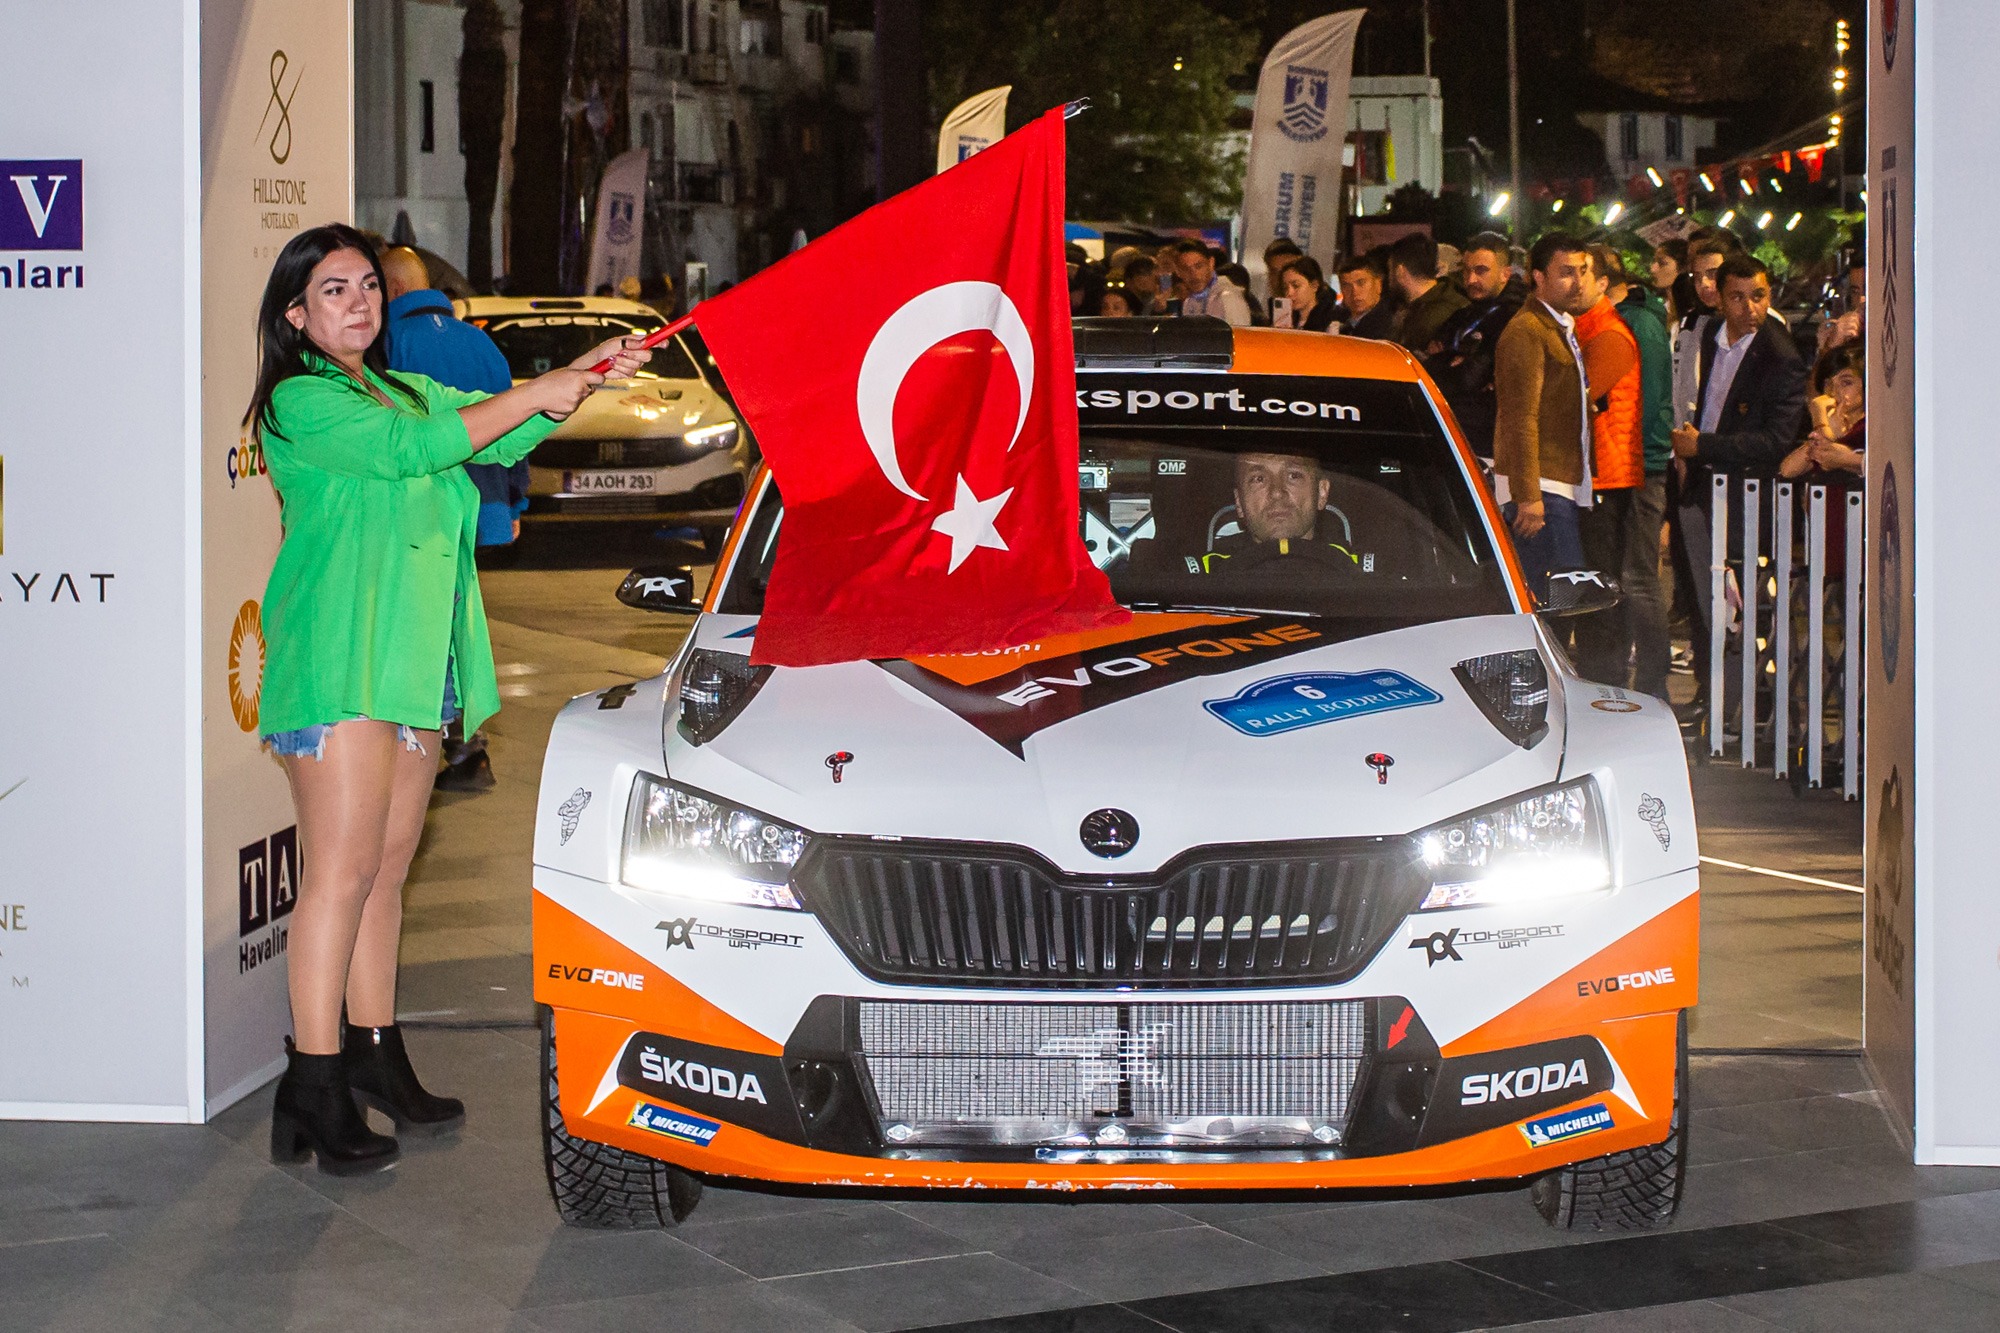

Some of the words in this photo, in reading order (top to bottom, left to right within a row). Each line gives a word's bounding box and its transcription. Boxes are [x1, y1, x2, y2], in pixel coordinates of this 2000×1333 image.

[253, 178, 306, 205] HILLSTONE
[1158, 461, 1186, 473] OMP
[574, 475, 591, 489] 34
[593, 473, 625, 489] AOH
[629, 473, 654, 490] 293
[0, 573, 115, 603] YAT
[997, 624, 1322, 706] EVOFONE
[1293, 685, 1327, 700] 6
[1246, 707, 1313, 729] RALLY
[1316, 688, 1421, 714] BODRUM
[695, 923, 804, 945] TOKSPORT
[728, 939, 762, 951] WRT
[1458, 924, 1564, 942] TOKSPORT
[1498, 939, 1530, 950] WRT
[548, 964, 645, 991] EVOFONE
[1577, 967, 1675, 997] EVOFONE
[639, 1045, 768, 1105] ŠKODA
[1461, 1058, 1589, 1106] SKODA
[651, 1115, 717, 1141] MICHELIN
[1547, 1110, 1611, 1137] MICHELIN
